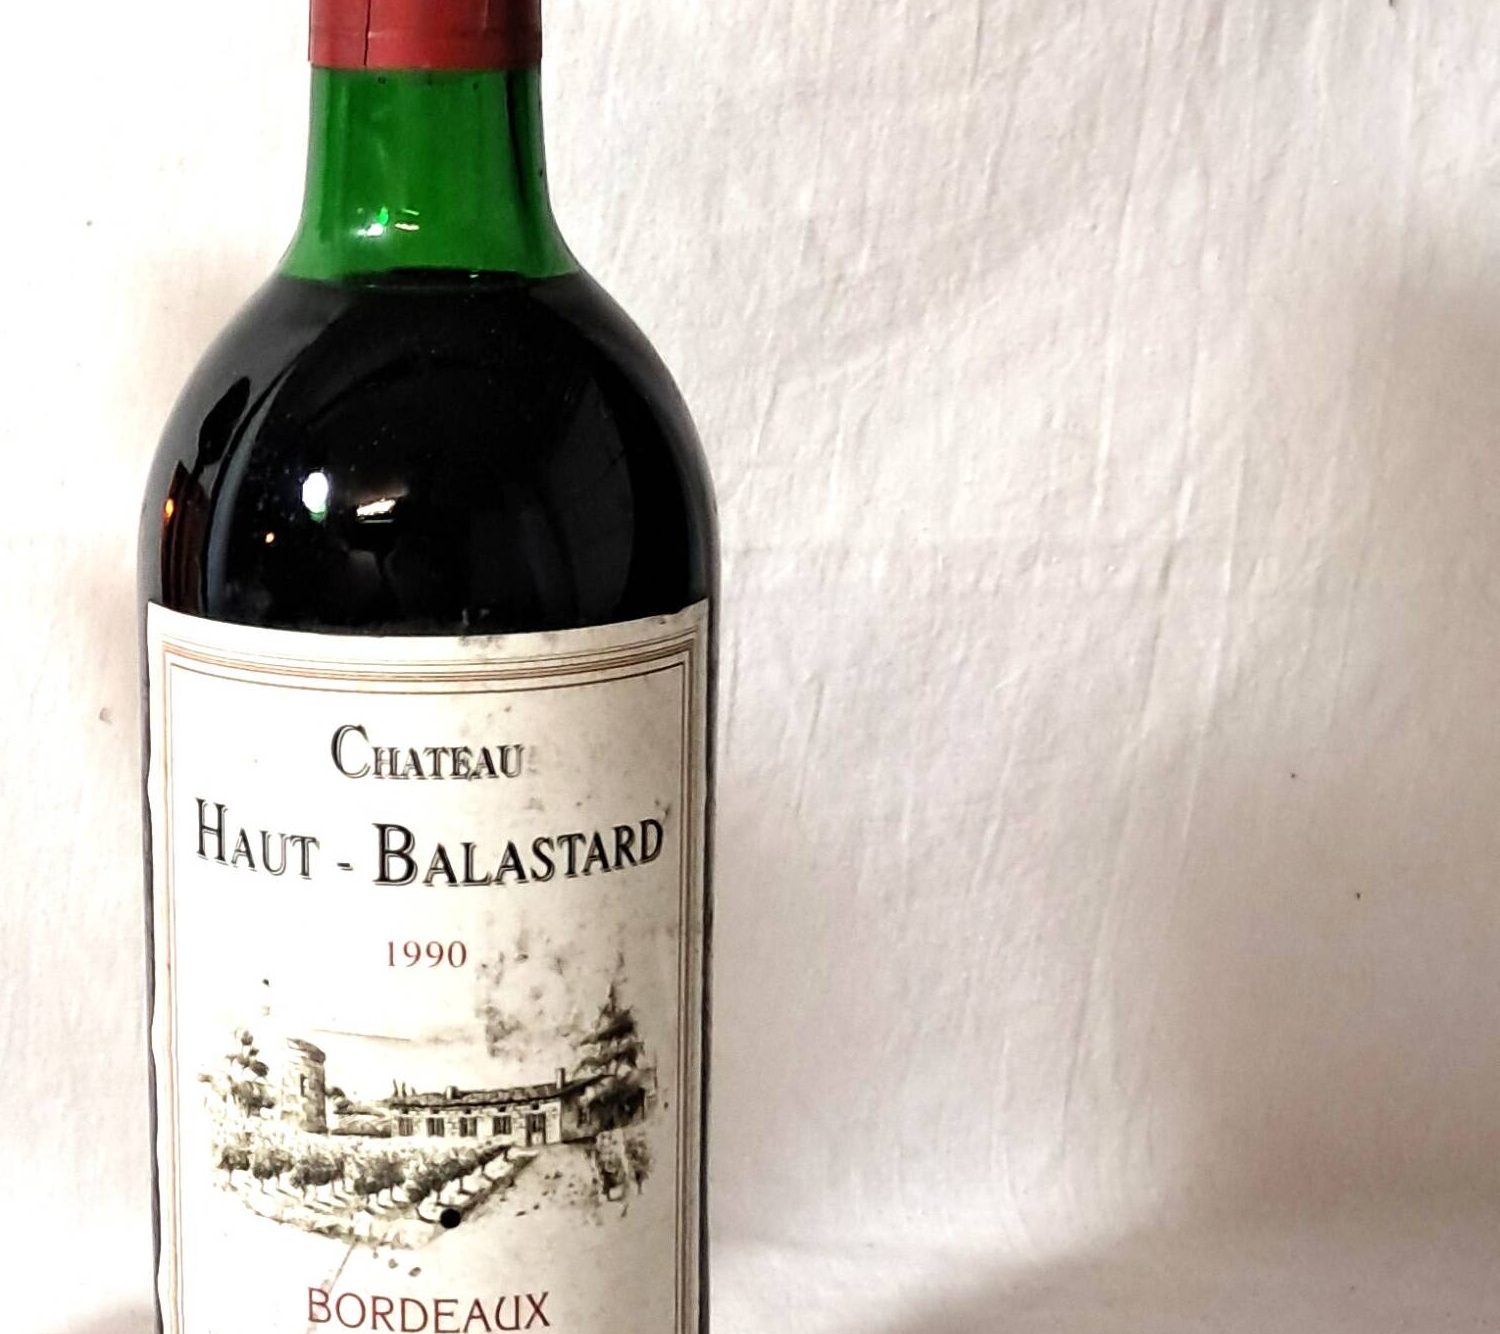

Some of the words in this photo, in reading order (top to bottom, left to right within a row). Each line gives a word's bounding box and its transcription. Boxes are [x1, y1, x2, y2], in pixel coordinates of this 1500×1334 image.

[331, 724, 525, 781] CHATEAU
[194, 797, 320, 881] HAUT
[372, 817, 665, 887] BALASTARD
[386, 940, 467, 968] 1990
[308, 1287, 550, 1334] BORDEAUX
